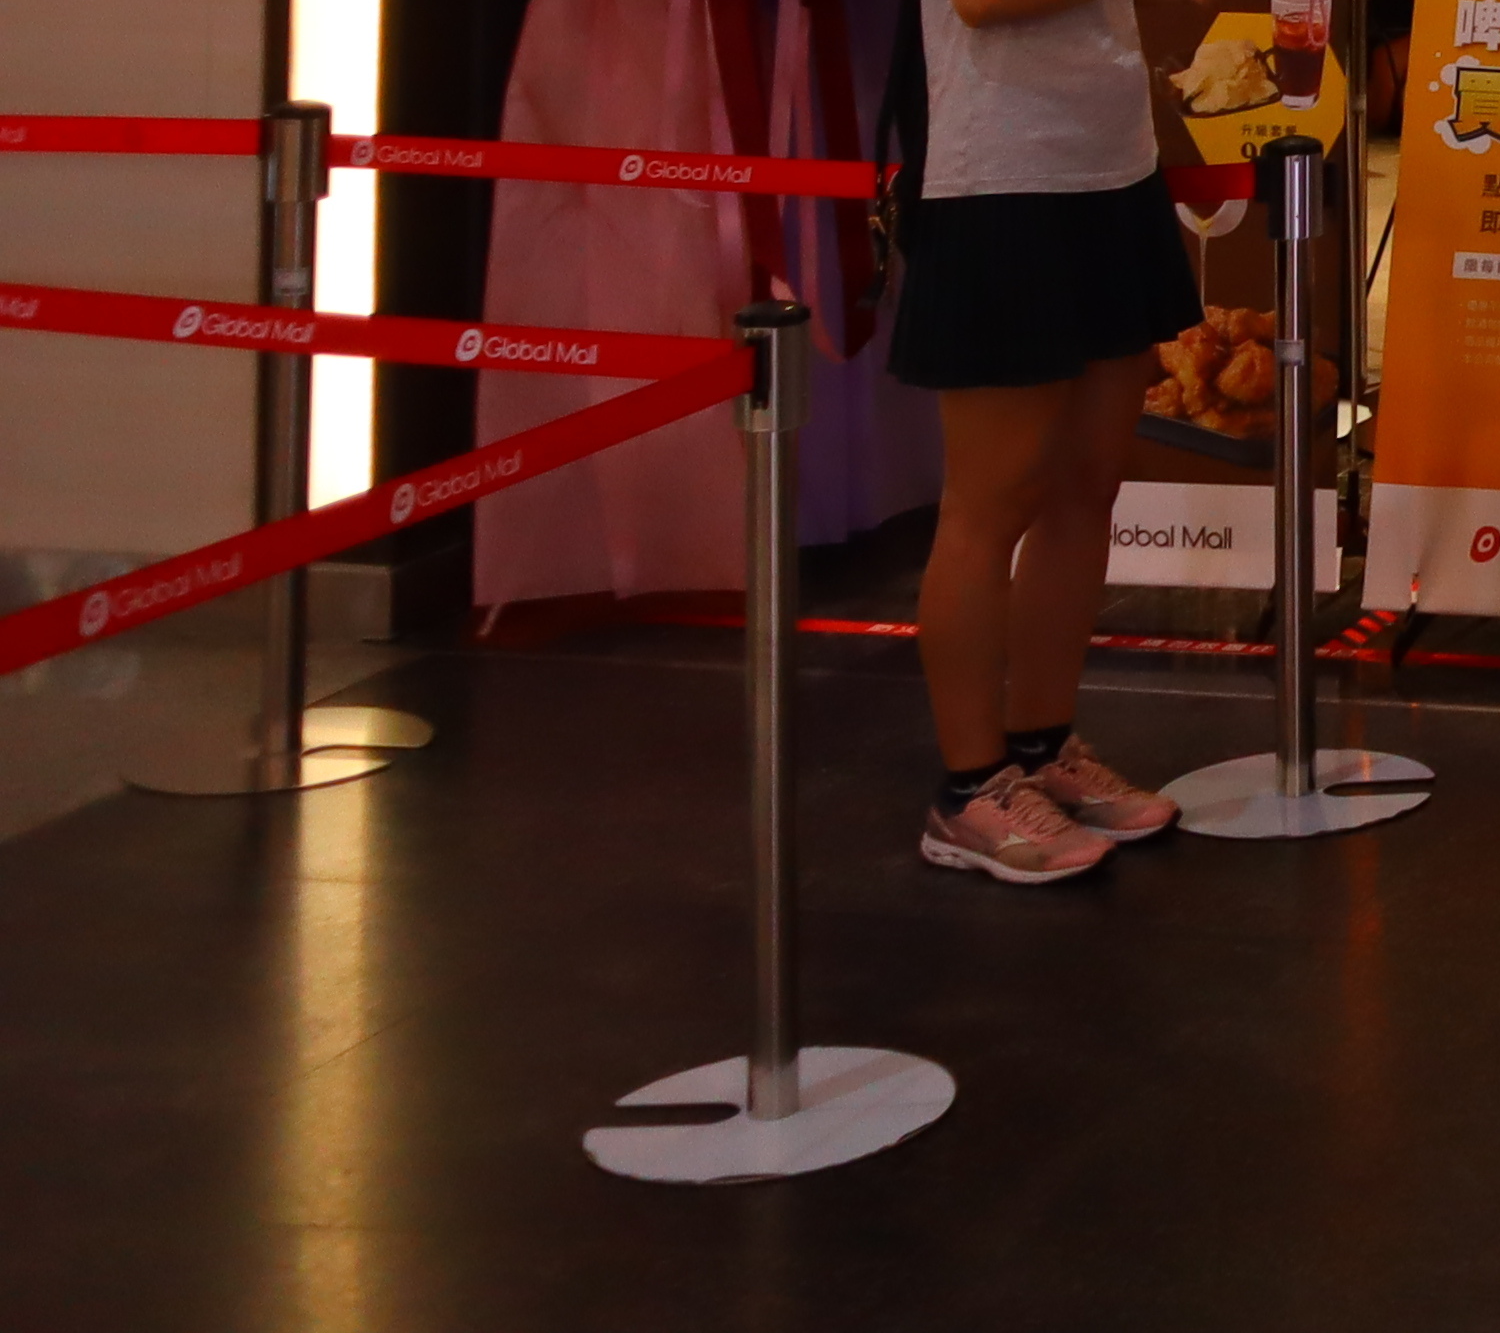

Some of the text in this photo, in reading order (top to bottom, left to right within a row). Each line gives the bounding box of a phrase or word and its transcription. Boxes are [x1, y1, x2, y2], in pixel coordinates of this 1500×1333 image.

[374, 144, 483, 168] Global Mall
[645, 159, 753, 185] Global Mall
[199, 310, 315, 344] Global Mall
[482, 335, 599, 366] Global Mall
[415, 449, 524, 508] Global Mall
[1108, 523, 1233, 550] lobal Mall
